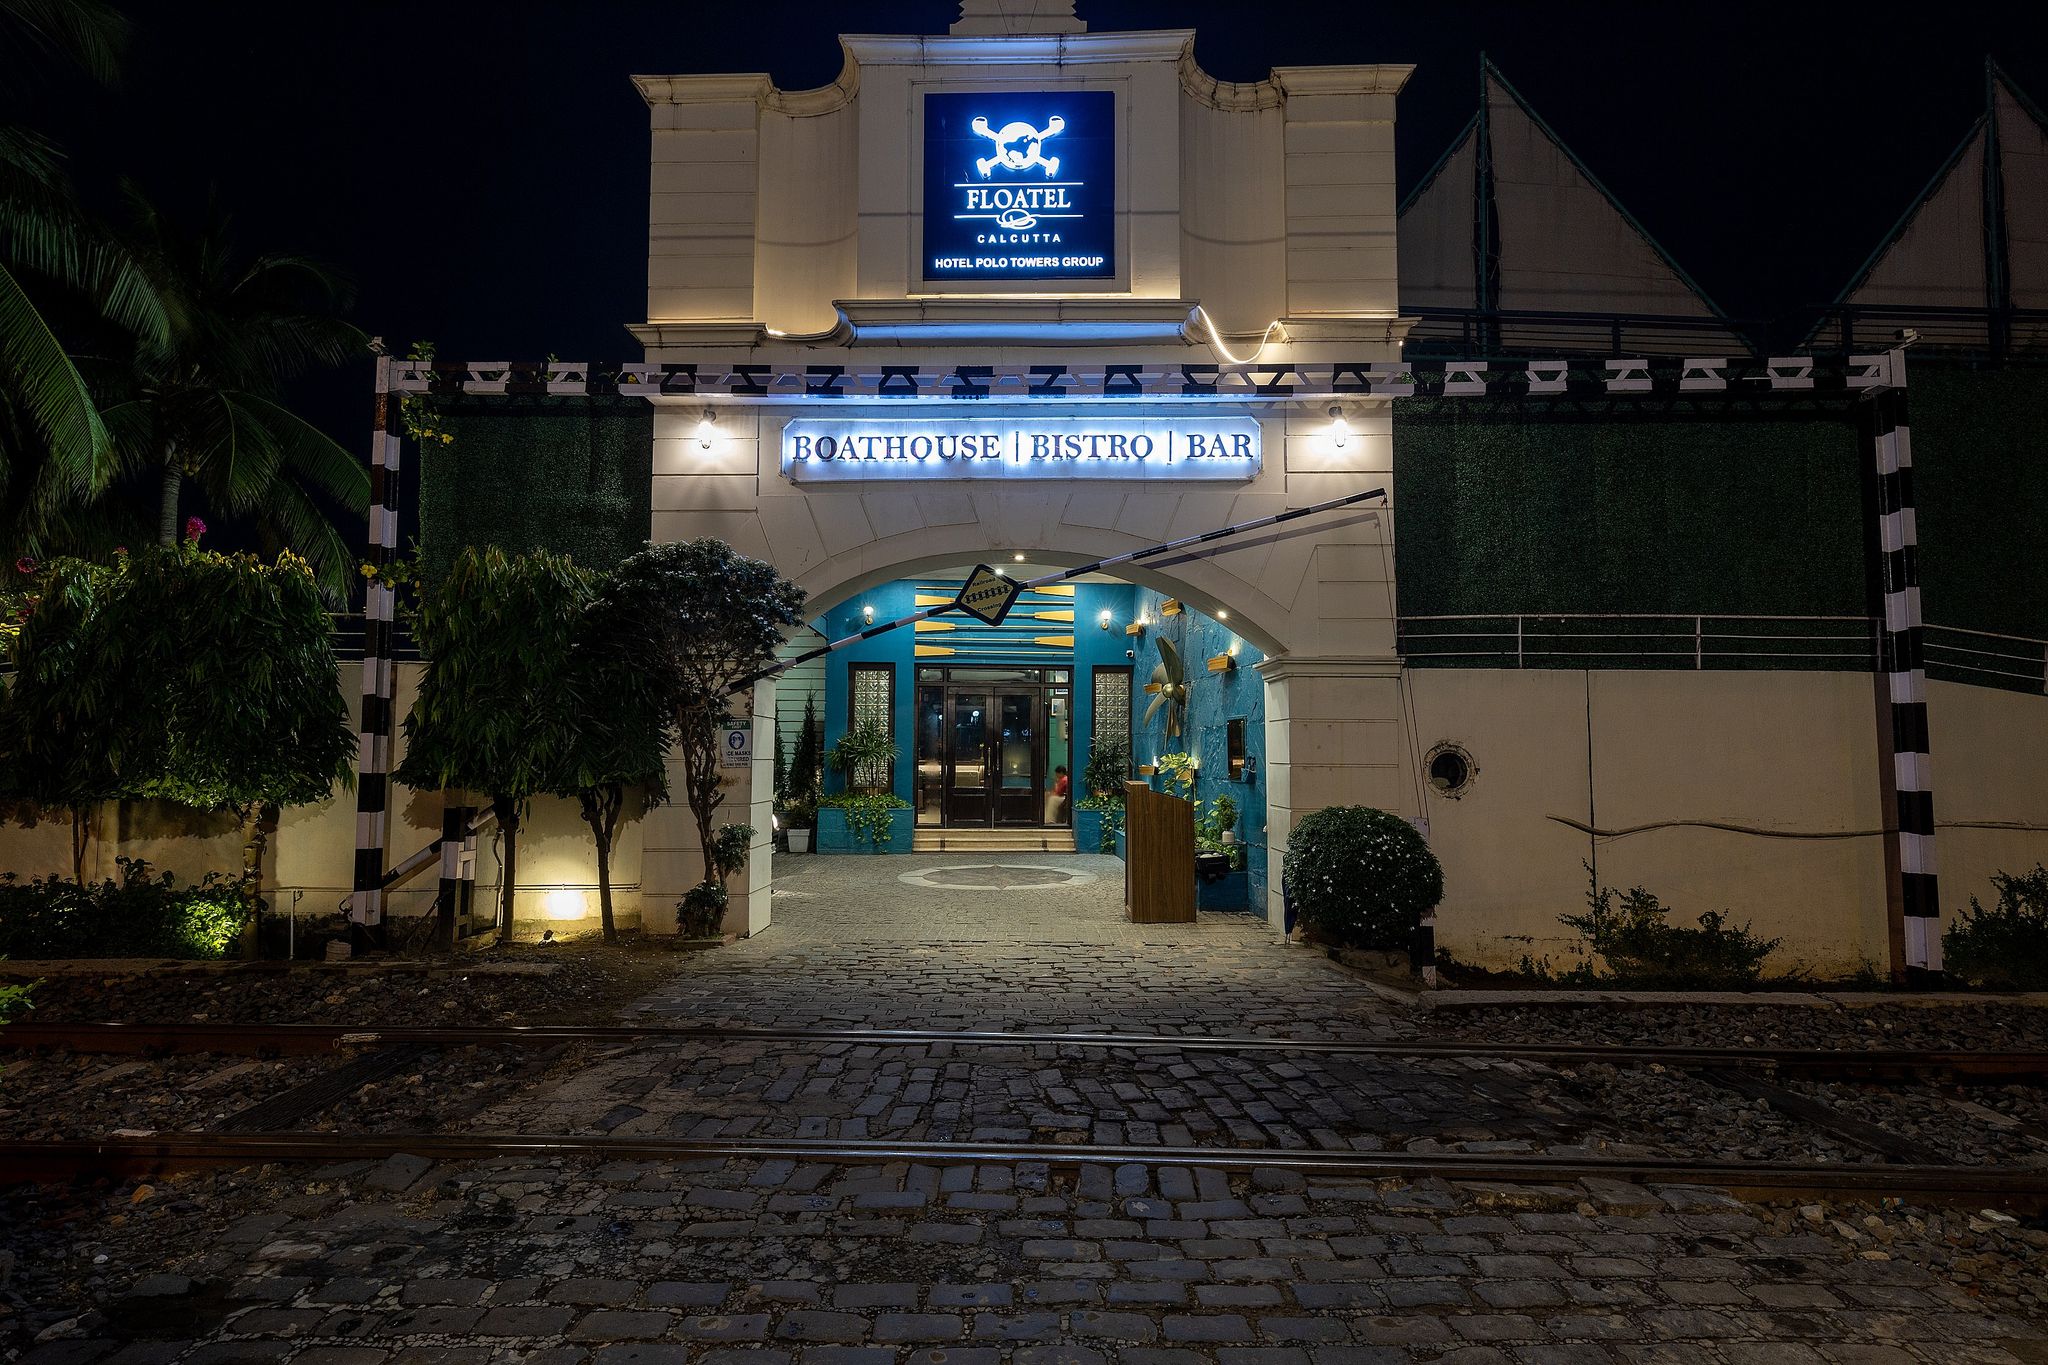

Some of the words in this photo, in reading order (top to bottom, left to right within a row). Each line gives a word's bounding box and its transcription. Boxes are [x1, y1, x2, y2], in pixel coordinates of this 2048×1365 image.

[966, 188, 1071, 209] FLOATEL
[977, 233, 1061, 244] CALCUTTA
[935, 257, 974, 269] HOTEL
[975, 257, 1008, 268] POLO
[1010, 257, 1060, 268] TOWERS
[1062, 256, 1104, 268] GROUP
[792, 435, 1001, 461] BOATHOUSE
[1030, 434, 1154, 460] BISTRO
[1187, 433, 1254, 460] BAR
[972, 577, 996, 587] Railroad
[977, 603, 1002, 612] Crossing
